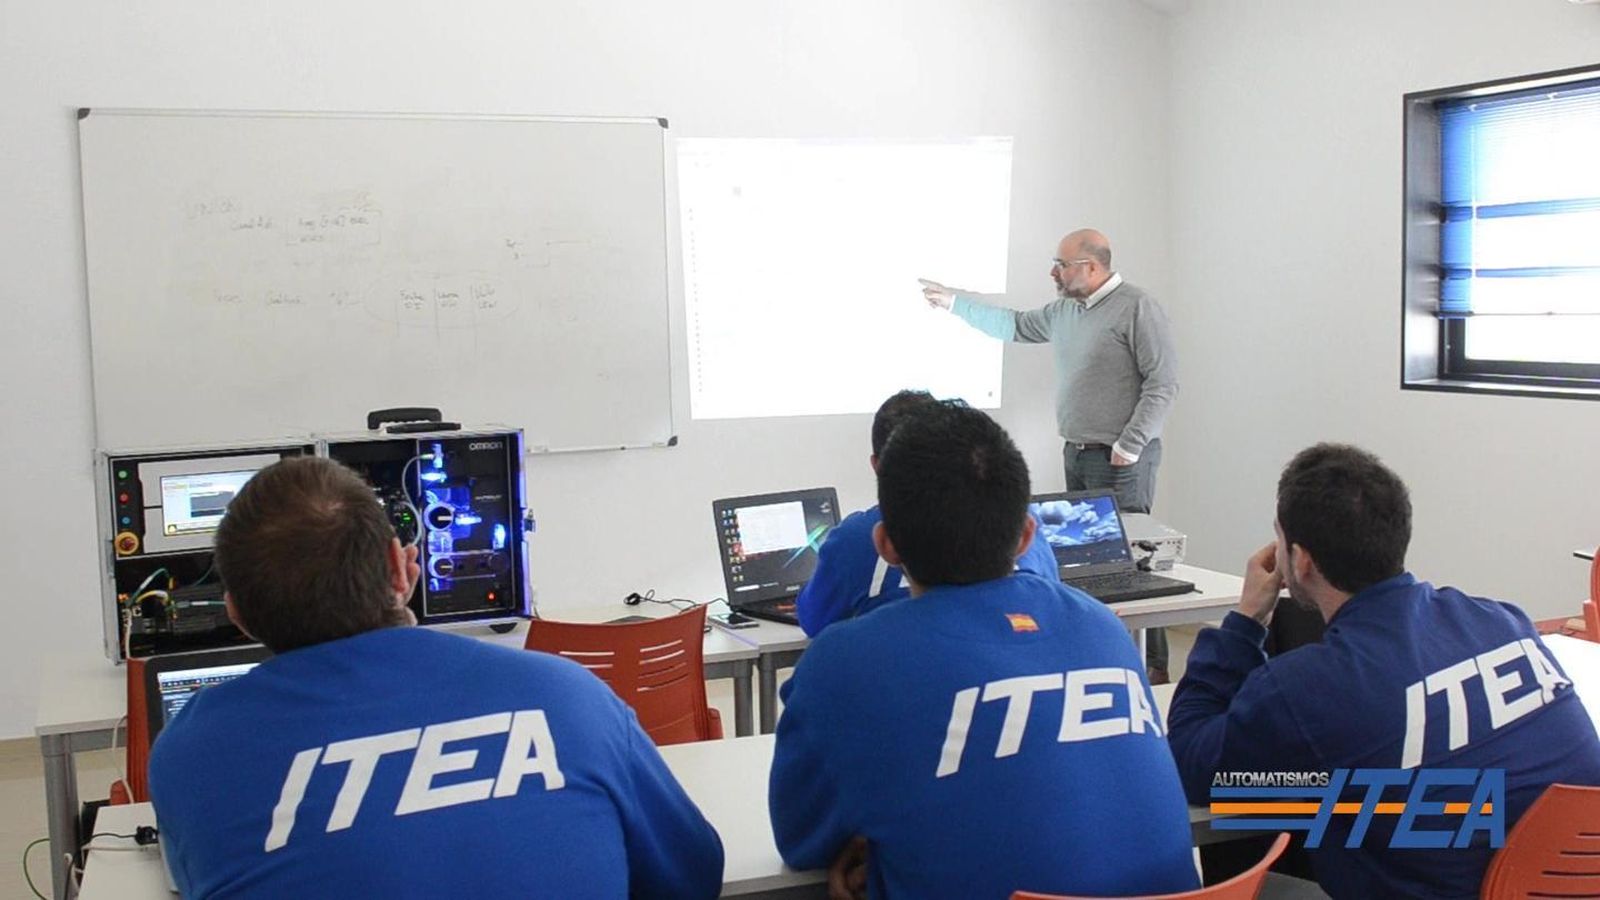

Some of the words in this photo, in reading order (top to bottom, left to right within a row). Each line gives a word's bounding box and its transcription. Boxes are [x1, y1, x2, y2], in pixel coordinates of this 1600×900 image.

[935, 667, 1162, 778] ITEA
[1402, 638, 1573, 769] ITEA
[264, 709, 566, 852] ITEA
